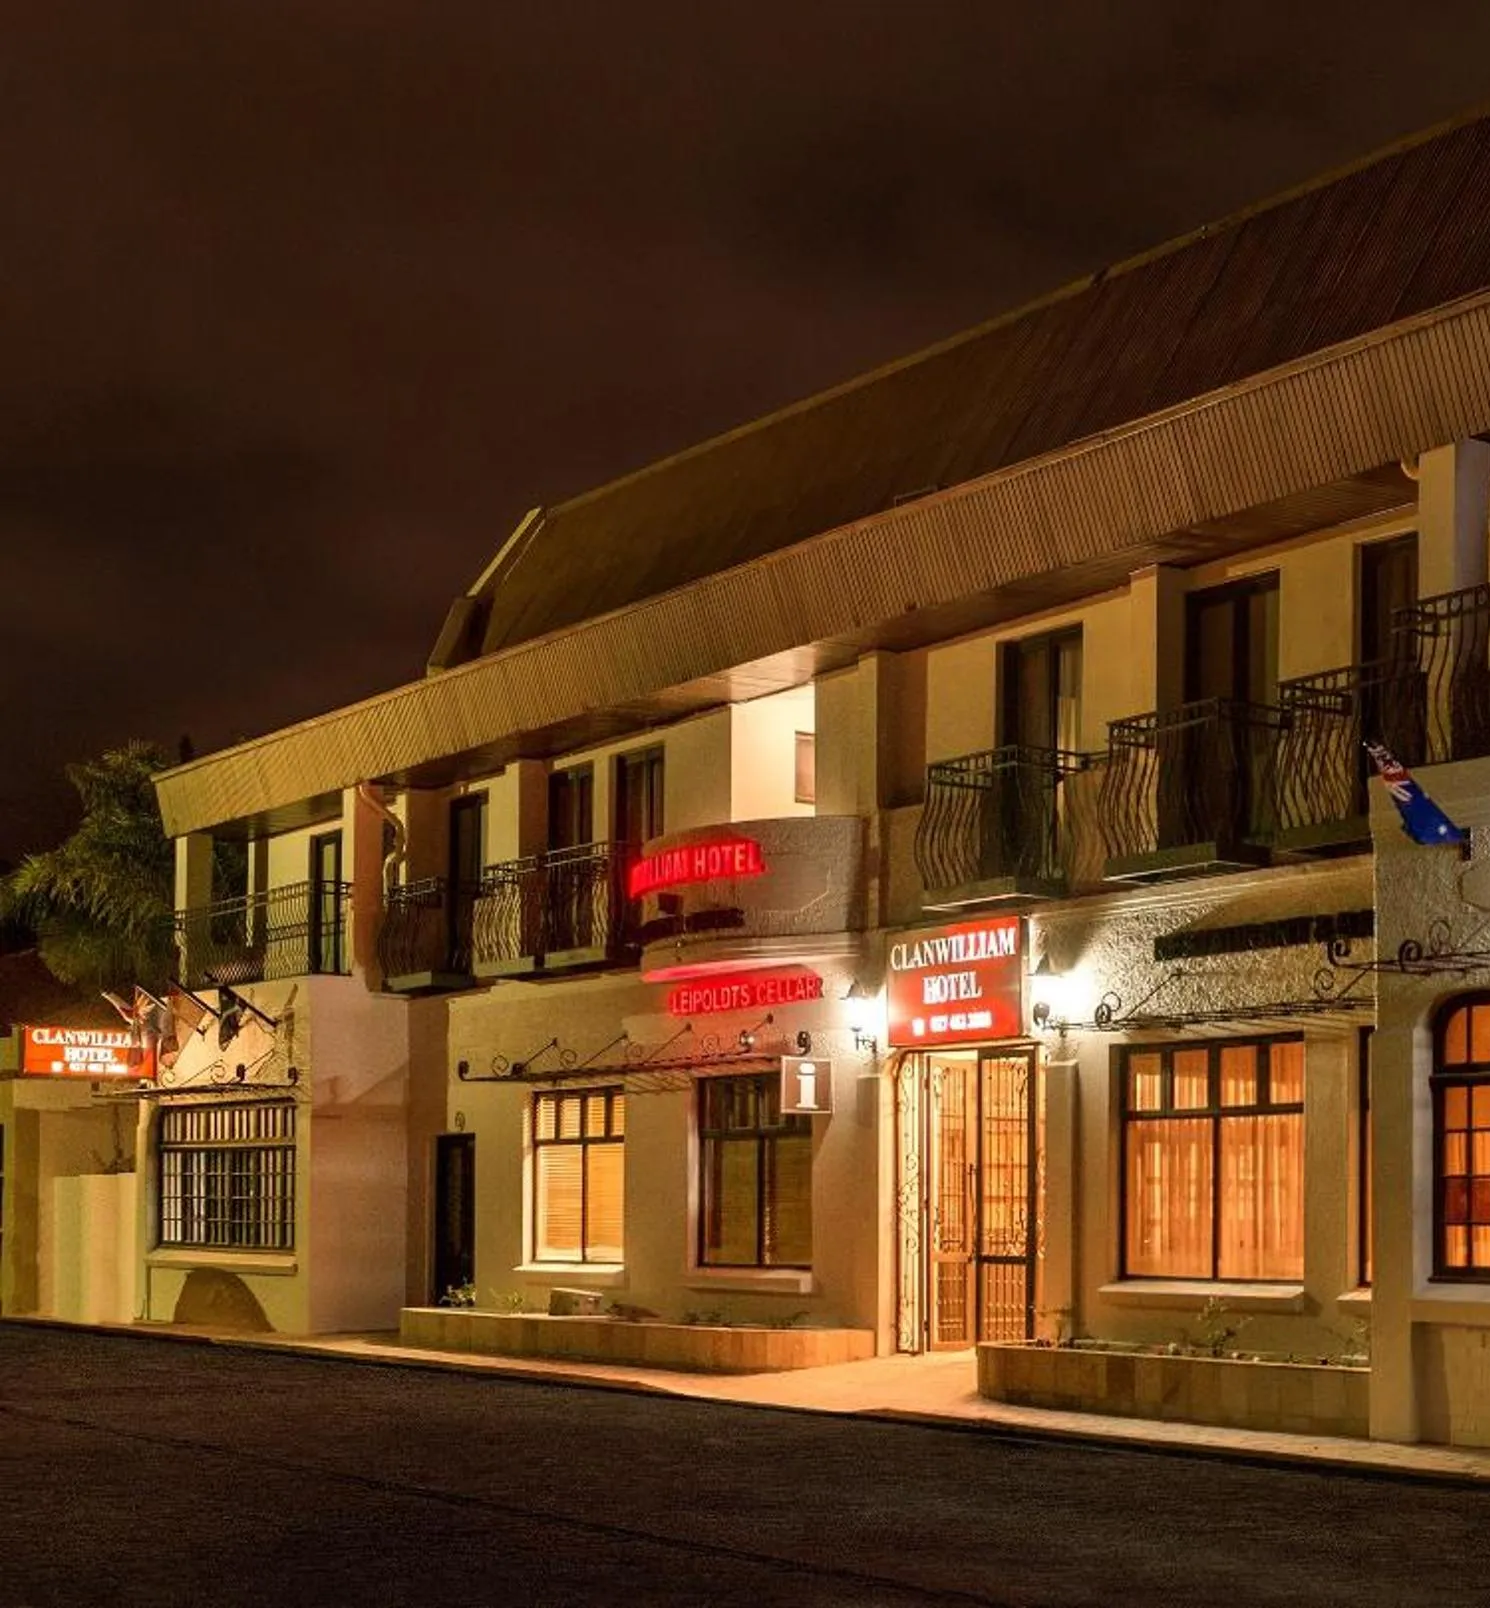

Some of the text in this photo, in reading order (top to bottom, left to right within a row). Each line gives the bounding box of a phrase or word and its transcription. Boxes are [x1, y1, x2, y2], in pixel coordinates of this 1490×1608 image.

[694, 842, 757, 878] HOTEL
[890, 927, 1017, 971] CLANWILLIAM
[756, 976, 824, 1005] CELLAR
[922, 971, 982, 1004] HOTEL
